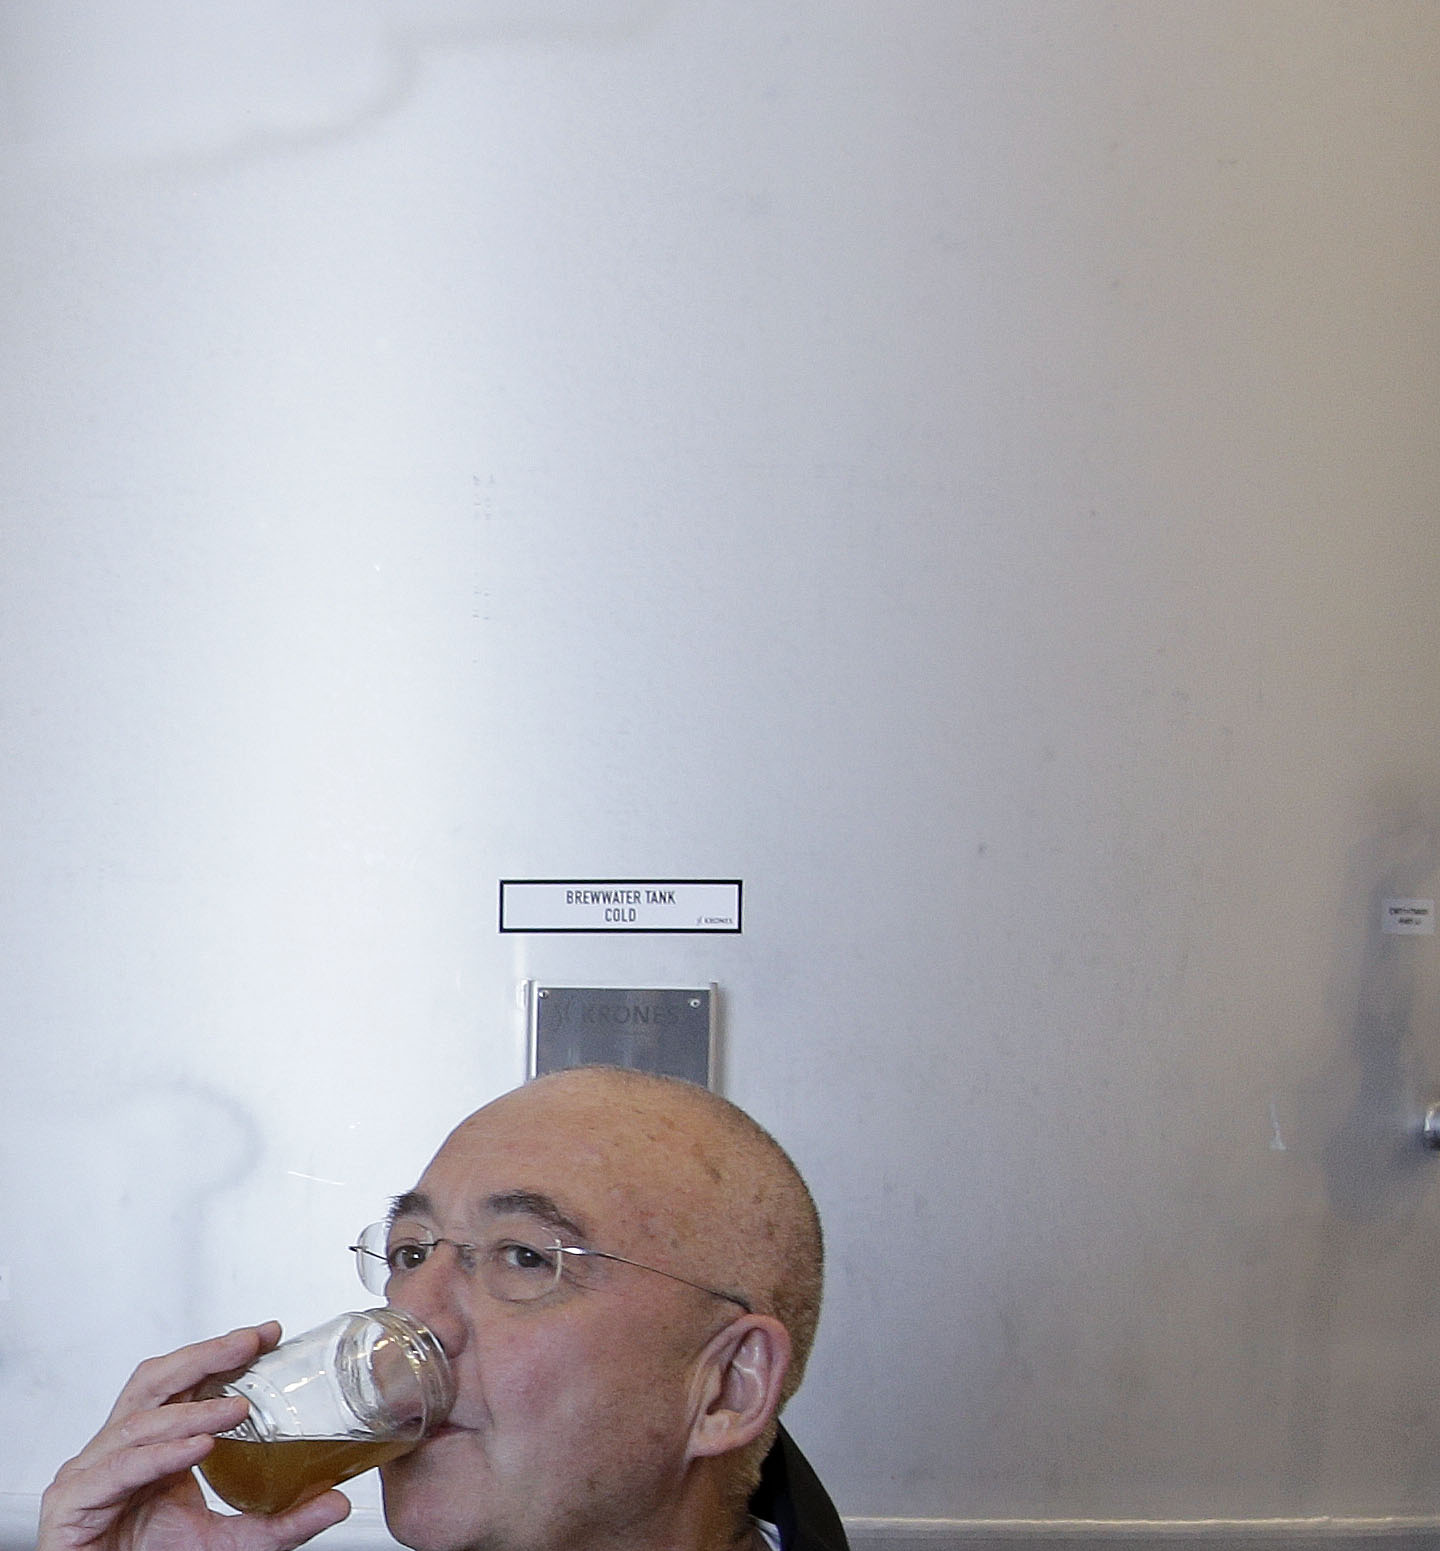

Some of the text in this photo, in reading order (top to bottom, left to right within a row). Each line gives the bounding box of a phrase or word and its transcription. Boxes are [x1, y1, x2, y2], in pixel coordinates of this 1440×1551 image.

[566, 890, 676, 904] BREWWATER TANK
[605, 908, 636, 922] COLD
[583, 1005, 679, 1025] KRONES
